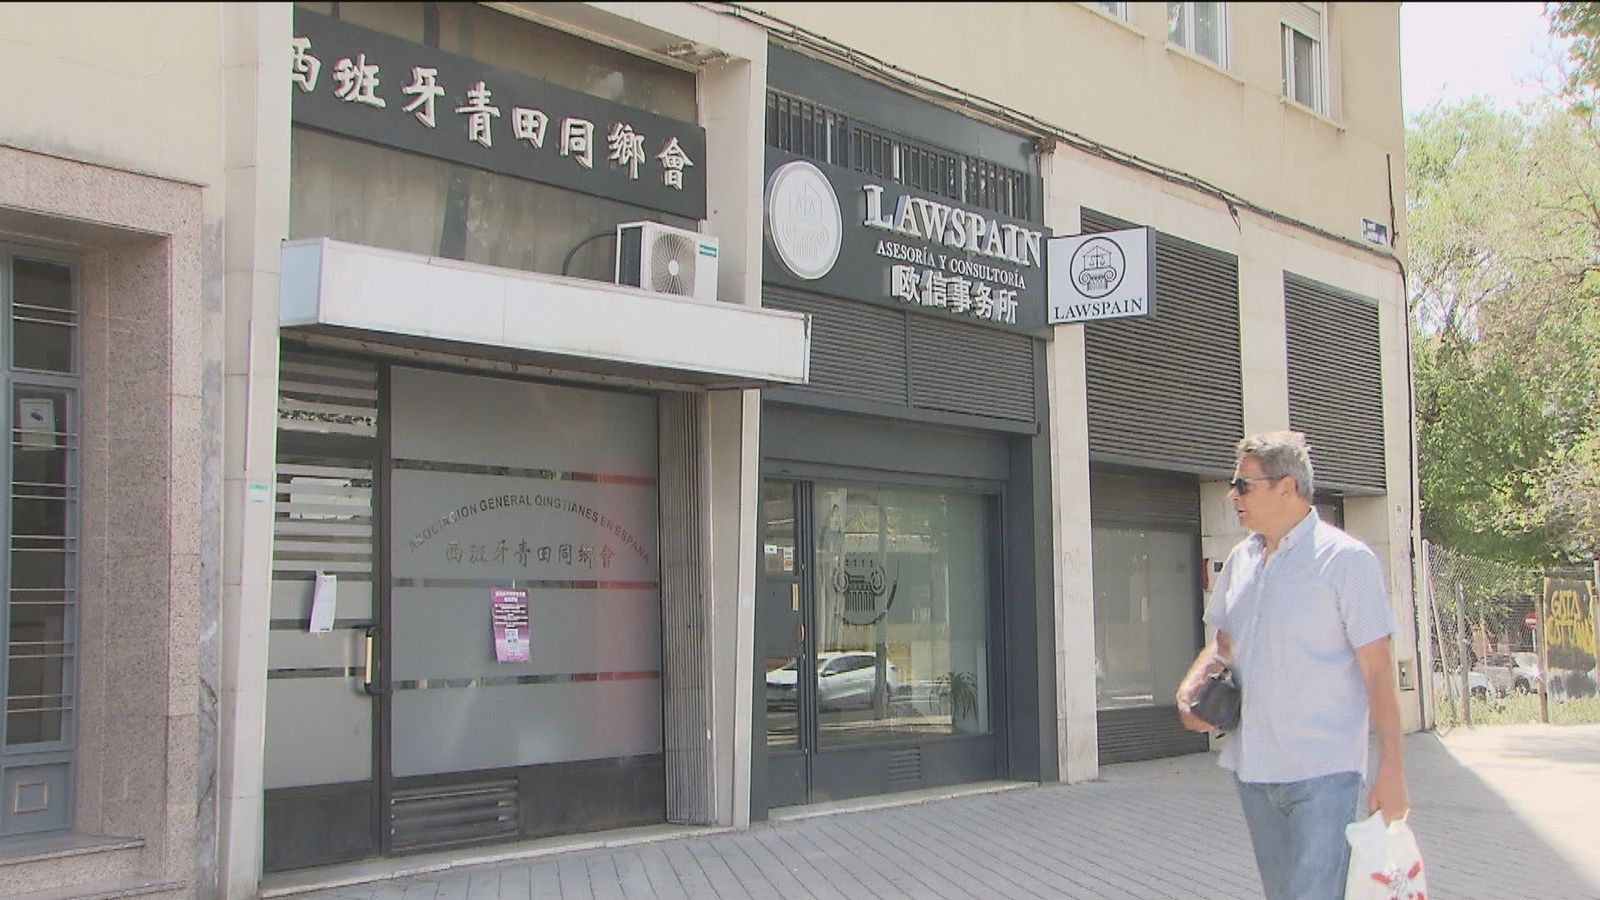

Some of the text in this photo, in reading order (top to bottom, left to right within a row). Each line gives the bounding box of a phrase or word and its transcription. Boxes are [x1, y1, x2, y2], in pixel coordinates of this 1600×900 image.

[863, 184, 1042, 268] LAWSPAIN
[876, 241, 1026, 290] ASESORÍA Y CONSULTORÍA
[891, 265, 1018, 325] 欧信事务所
[1054, 297, 1143, 321] LAWSPAIN
[479, 495, 532, 512] GENERAL
[535, 495, 598, 523] QINGTIANES
[600, 515, 614, 530] EN
